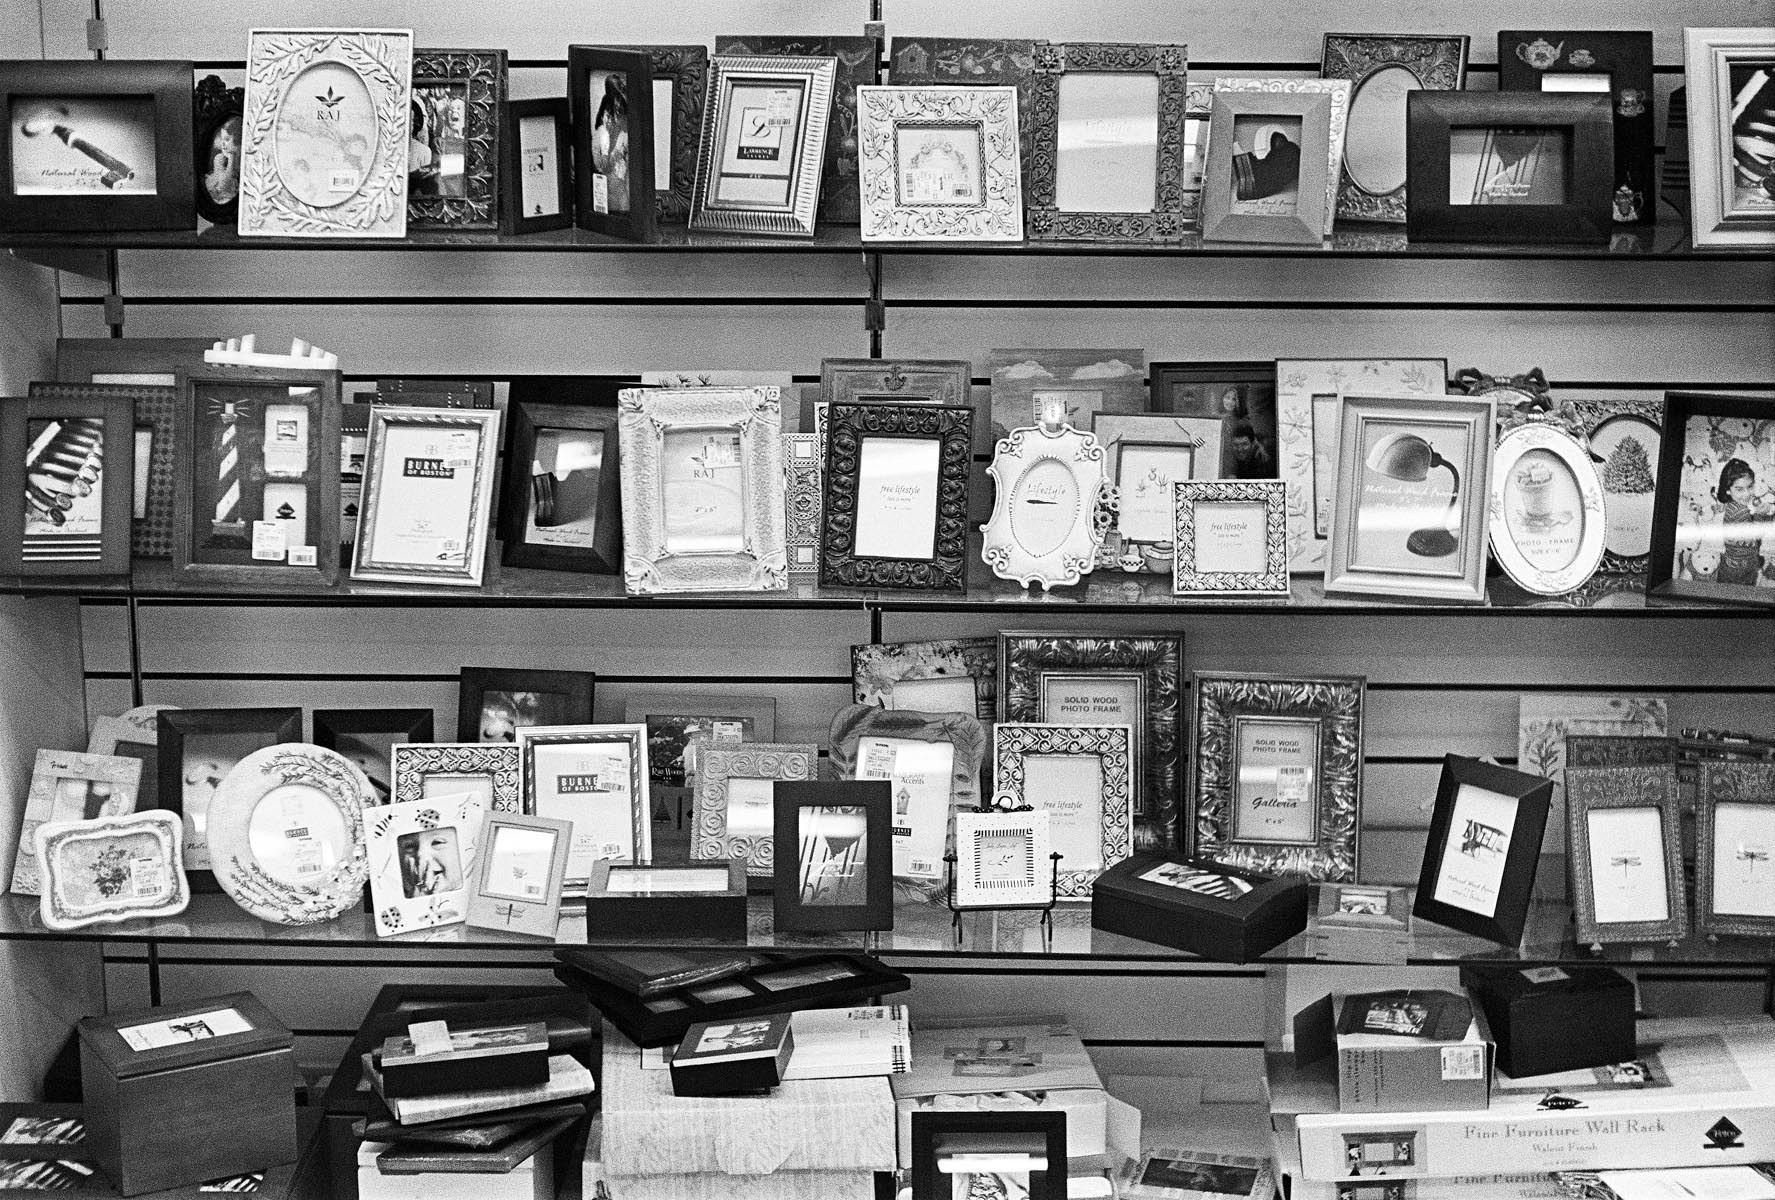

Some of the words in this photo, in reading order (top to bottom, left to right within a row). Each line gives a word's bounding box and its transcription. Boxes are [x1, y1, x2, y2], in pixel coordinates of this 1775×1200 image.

[316, 110, 341, 121] RAJ
[41, 168, 77, 177] Natural
[80, 167, 104, 177] Wood
[407, 460, 450, 470] BURNE
[693, 468, 714, 480] RAJ
[880, 484, 894, 495] free
[895, 484, 921, 495] lifestyle
[1211, 522, 1223, 532] free
[1224, 521, 1248, 532] lifestyle
[1063, 696, 1089, 704] SOLID
[1092, 696, 1118, 704] WOOD
[1092, 705, 1122, 713] FRAME
[561, 777, 598, 786] BURNE
[1057, 800, 1083, 811] lifestyle
[1251, 797, 1297, 810] Galleria
[1464, 1125, 1499, 1139] Fine
[1505, 1123, 1580, 1138] Furniture
[1585, 1119, 1619, 1135] Wall
[1627, 1119, 1666, 1134] Rack
[1532, 1143, 1564, 1152] Walnut
[1568, 1142, 1598, 1151] Finish
[1452, 1174, 1487, 1185] Fine
[1494, 1173, 1550, 1184] Furnitu
